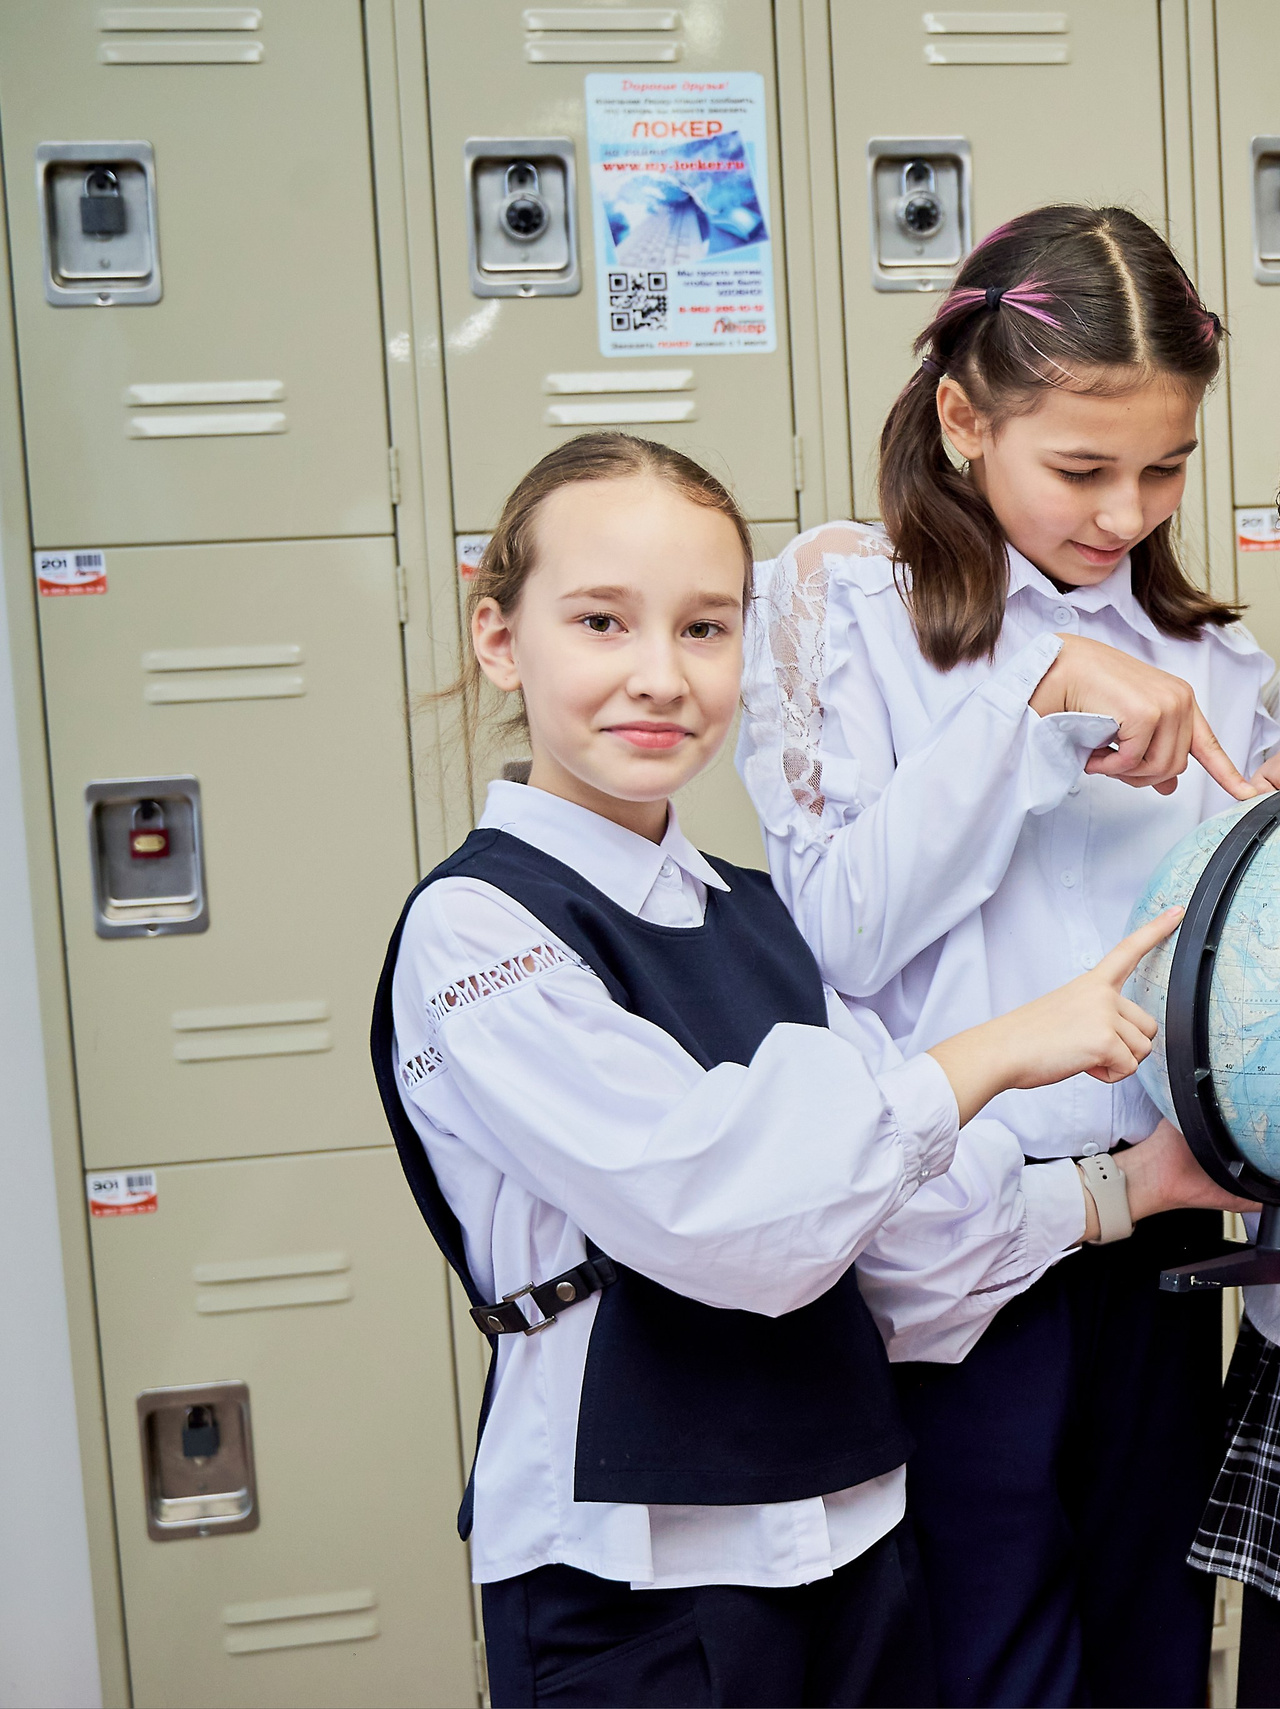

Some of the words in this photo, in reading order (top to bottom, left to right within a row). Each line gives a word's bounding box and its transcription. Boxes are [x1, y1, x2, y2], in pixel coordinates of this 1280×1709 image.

[632, 120, 723, 138] ЛОКЕР
[603, 160, 745, 173] www.my-locker.ru
[41, 559, 67, 569] 201
[94, 1181, 118, 1191] 301
